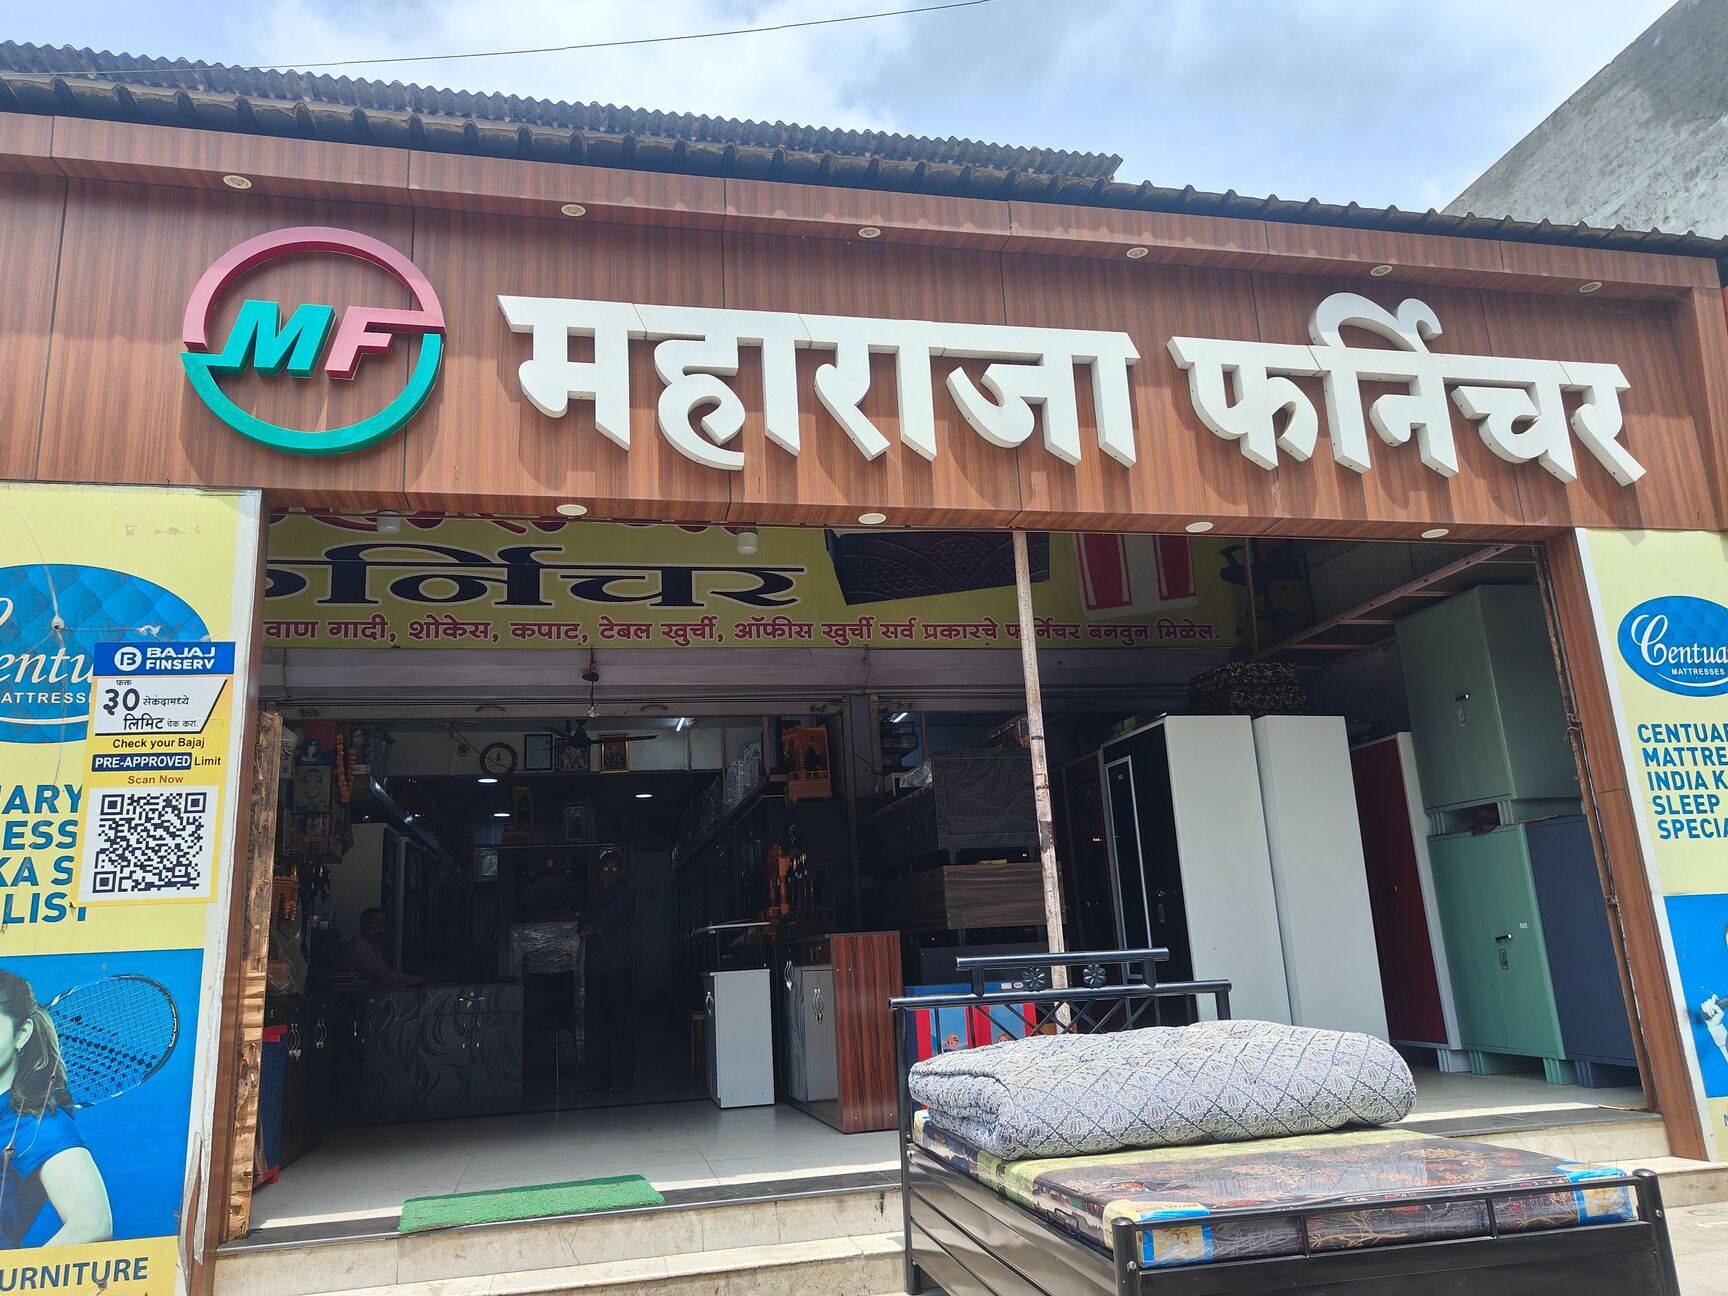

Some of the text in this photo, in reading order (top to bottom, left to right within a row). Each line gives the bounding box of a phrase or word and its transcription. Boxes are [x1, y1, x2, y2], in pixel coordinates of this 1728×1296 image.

[497, 292, 1647, 487] महाराजा फर्निचर
[327, 613, 397, 642] गादी,
[408, 614, 499, 643] शोकेस,
[510, 622, 589, 643] कपाट,
[599, 615, 653, 640] टेबल
[660, 615, 724, 646] खुर्ची,
[734, 616, 814, 639] ऑफीस
[820, 616, 875, 646] खुर्ची
[880, 616, 917, 640] सर्व
[922, 616, 998, 640] प्रकारचे
[1087, 624, 1150, 646] बनवुन
[1156, 618, 1221, 640] मिळेल.
[1631, 614, 1728, 666] Centua
[146, 647, 216, 658] BAJAJ
[145, 659, 215, 670] FINSERV
[1671, 668, 1725, 676] MATTRESSES
[0, 692, 91, 704] ATTRESS
[103, 688, 140, 715] ३०
[123, 712, 165, 730] लिमिट
[112, 737, 205, 749] Check your Bajaj
[95, 755, 221, 768] PRE-APPROVED Limit
[127, 775, 184, 784] Scan Now
[1647, 770, 1709, 791] INDIA
[0, 784, 83, 814] ARY
[1652, 794, 1720, 815] SLEEP
